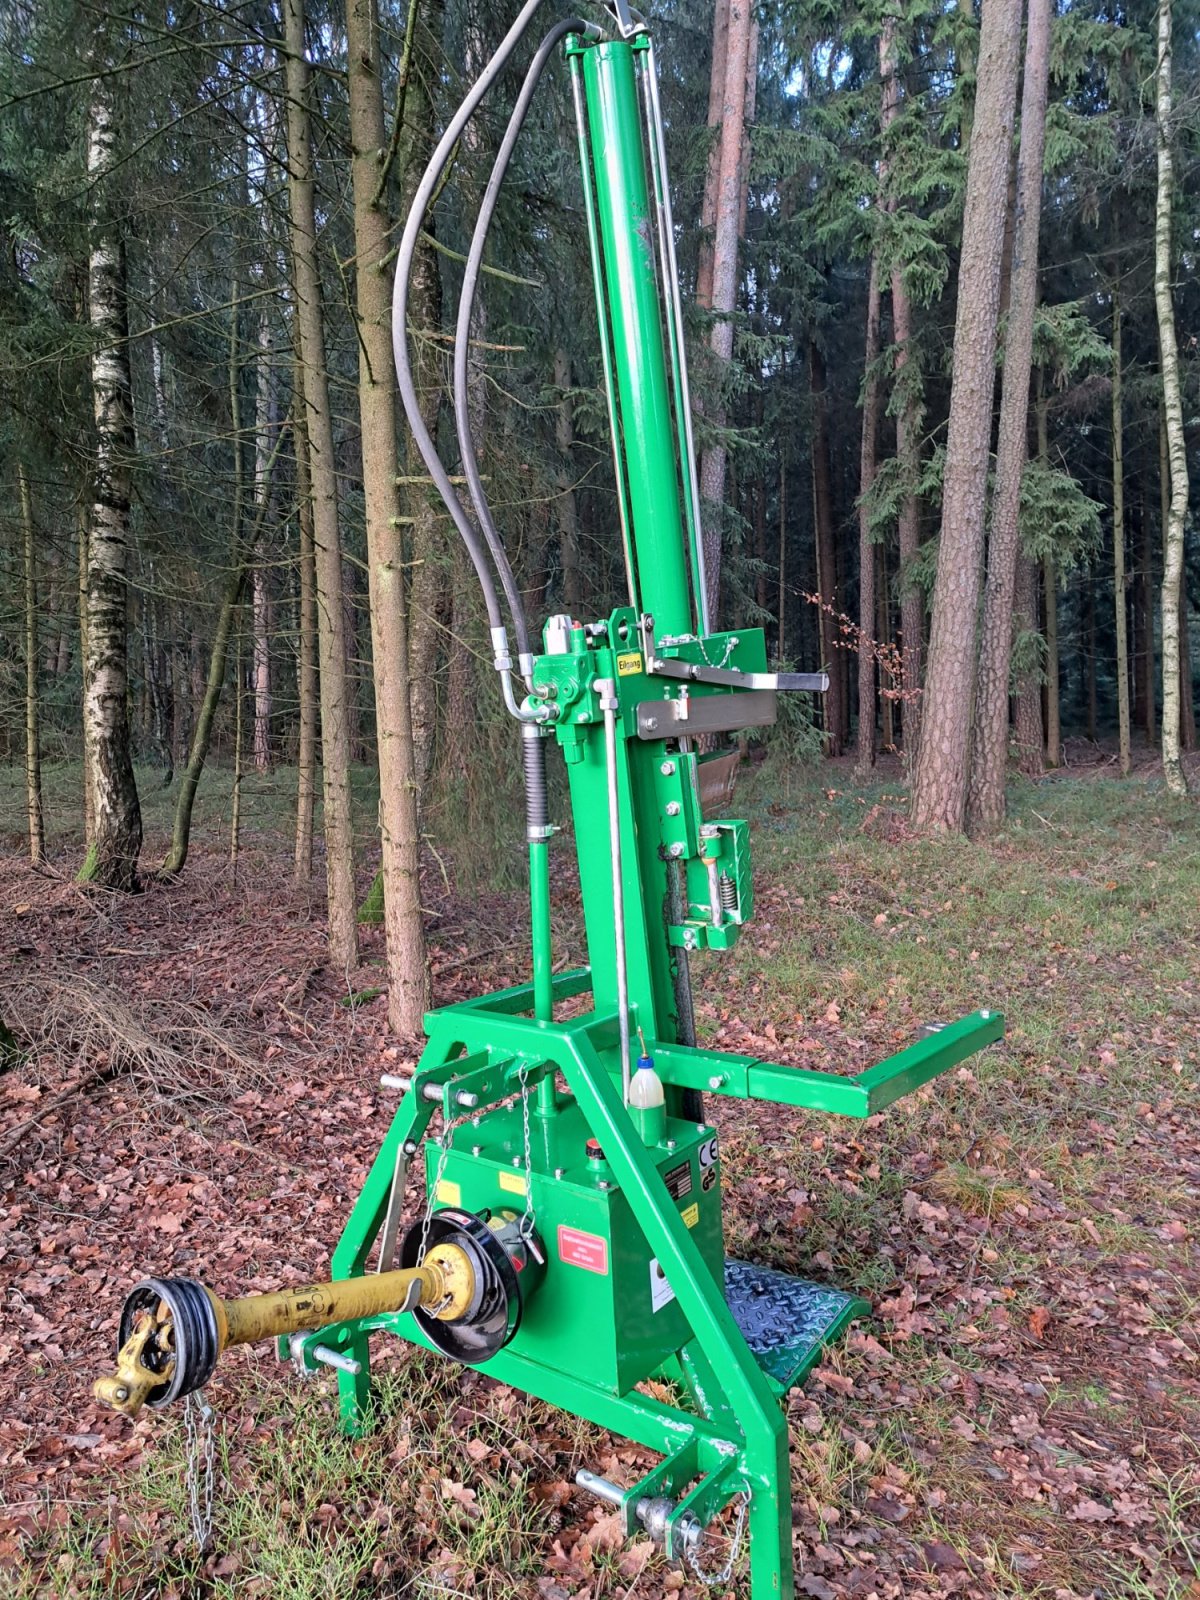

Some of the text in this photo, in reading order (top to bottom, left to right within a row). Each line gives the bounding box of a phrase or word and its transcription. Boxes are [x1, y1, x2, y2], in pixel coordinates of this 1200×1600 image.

[619, 660, 641, 671] Eilgang
[699, 1138, 718, 1168] CE
[702, 1167, 716, 1191] GS
